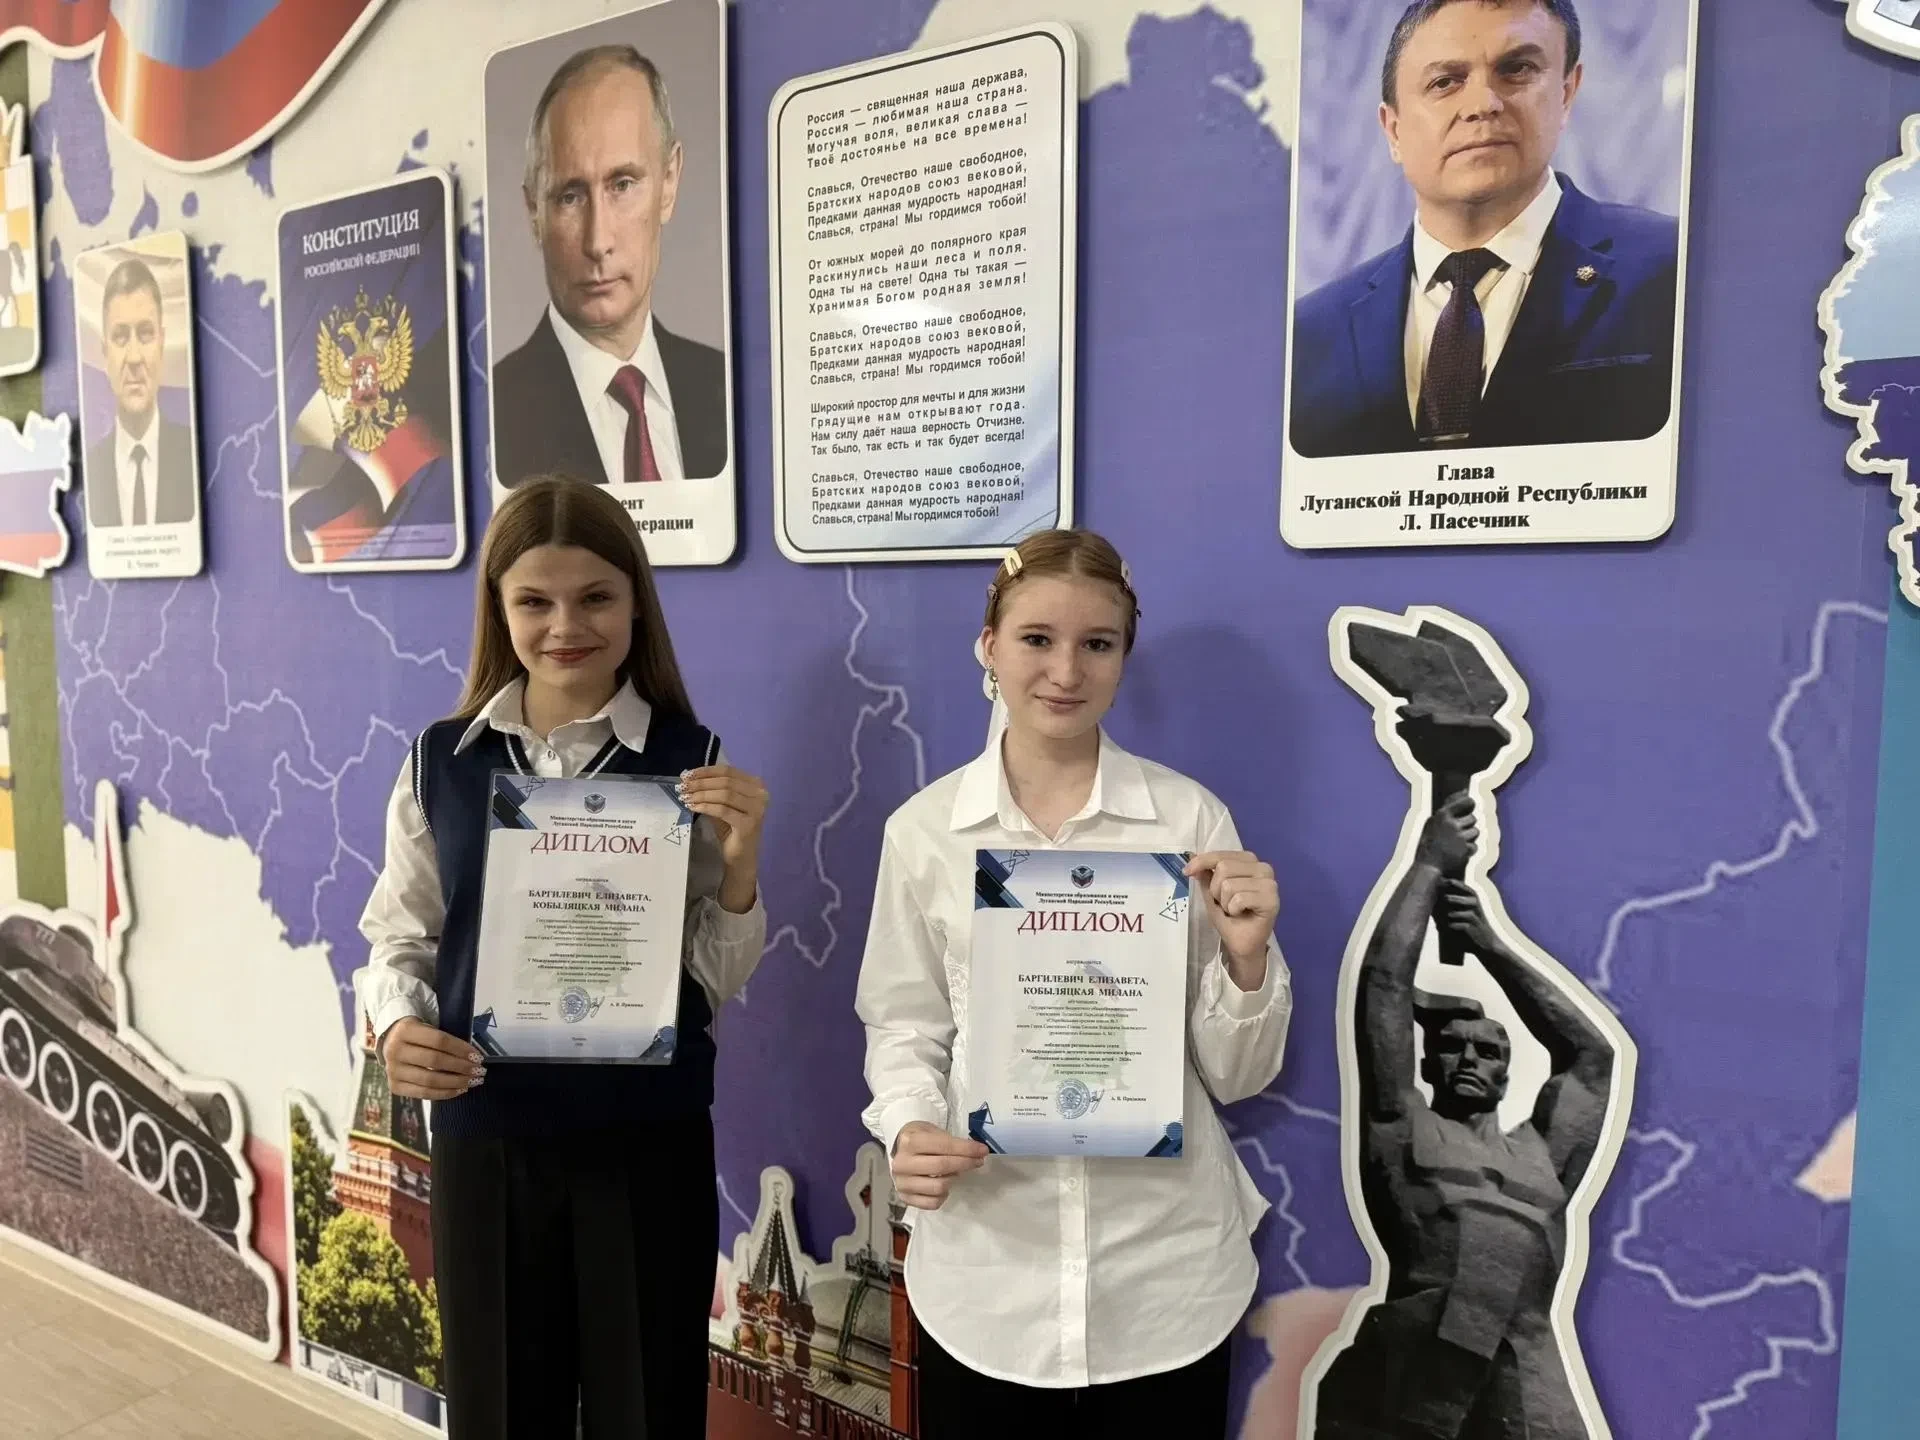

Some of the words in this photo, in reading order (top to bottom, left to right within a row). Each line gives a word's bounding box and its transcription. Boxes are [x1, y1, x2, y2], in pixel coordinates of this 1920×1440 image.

[807, 109, 844, 125] Россия
[866, 89, 928, 112] священная
[935, 81, 965, 96] наша
[971, 68, 1027, 89] держава,
[807, 123, 848, 139] Россия
[872, 105, 928, 126] любимая
[936, 96, 968, 111] наша
[976, 84, 1027, 103] страна.
[807, 136, 857, 154] Могучая
[864, 127, 898, 142] воля,
[906, 113, 959, 133] великая
[967, 103, 1007, 119] слава
[807, 153, 836, 168] Твоё
[840, 140, 906, 163] достоянье
[913, 135, 927, 147] на
[935, 129, 956, 142] все
[964, 113, 1026, 136] времена!
[807, 181, 854, 197] Славься,
[860, 168, 917, 187] Отечество
[923, 161, 952, 175] наше
[959, 148, 1026, 168] свободное,
[808, 192, 861, 212] Братских
[868, 183, 920, 201] народов
[927, 175, 959, 189] союз
[967, 162, 1026, 182] вековой,
[807, 210, 858, 227] Предками
[863, 201, 901, 217] данная
[907, 191, 960, 208] мудрость
[967, 177, 1026, 198] народная!
[808, 226, 853, 241] Славься,
[859, 215, 898, 232] страна!
[904, 213, 922, 224] Мы
[929, 202, 981, 220] гордимся
[987, 193, 1026, 209] тобой!
[303, 209, 419, 255] КОНСТИТУЦИЯ
[808, 259, 822, 269] От
[827, 253, 864, 267] южных
[870, 245, 904, 261] морей
[909, 243, 924, 255] до
[931, 232, 992, 251] полярного
[999, 226, 1026, 240] края
[304, 254, 363, 279] РОССИЙСКОЙ
[808, 265, 888, 285] Раскинулись
[895, 258, 927, 271] наши
[935, 252, 965, 265] леса
[973, 249, 980, 259] и
[988, 243, 1026, 257] поля.
[808, 287, 834, 299] Одна
[840, 284, 854, 294] ты
[860, 281, 872, 291] на
[878, 274, 912, 288] свете!
[918, 269, 947, 283] Одна
[953, 267, 969, 277] ты
[975, 261, 1007, 274] такая
[809, 297, 868, 314] Хранимая
[876, 290, 915, 304] Богом
[923, 282, 970, 299] родная
[979, 273, 1025, 289] земля!
[809, 329, 856, 342] Славься,
[862, 320, 917, 335] Отечество
[924, 316, 952, 327] наше
[959, 306, 1025, 323] свободное,
[810, 342, 863, 356] Братских
[870, 335, 921, 349] народов
[928, 330, 959, 342] союз
[967, 321, 1025, 337] вековой,
[810, 357, 859, 371] Предками
[864, 352, 902, 366] данная
[908, 346, 960, 360] мудрость
[966, 336, 1025, 353] народная!
[810, 373, 855, 385] Славься,
[861, 365, 899, 380] страна!
[905, 363, 923, 374] Мы
[929, 358, 981, 372] гордимся
[987, 351, 1025, 365] тобой!
[810, 399, 854, 413] Широкий
[857, 397, 897, 409] простор
[900, 395, 919, 406] для
[922, 391, 955, 402] мечты
[958, 391, 965, 399] и
[967, 388, 988, 399] для
[990, 384, 1025, 396] жизни
[811, 414, 870, 428] Грядущие
[877, 411, 900, 421] нам
[908, 404, 981, 419] открывают
[989, 400, 1024, 412] года.
[811, 431, 830, 441] Нам
[835, 430, 858, 440] силу
[862, 426, 886, 438] даёт
[890, 425, 916, 435] наша
[922, 420, 971, 433] верность
[976, 416, 1024, 428] Отчизне.
[812, 445, 827, 455] Так
[831, 444, 860, 454] было,
[865, 442, 882, 451] так
[886, 440, 909, 450] есть
[913, 439, 921, 448] и
[926, 437, 943, 447] так
[948, 434, 979, 446] будет
[985, 430, 1024, 442] всегда!
[811, 473, 857, 483] Славься,
[863, 468, 918, 479] Отечество
[924, 466, 952, 476] наше
[958, 462, 1024, 474] свободное,
[812, 485, 864, 497] Братских
[871, 483, 921, 494] народов
[928, 480, 959, 491] союз
[967, 476, 1024, 488] вековой,
[1437, 464, 1495, 481] Глава
[812, 500, 860, 511] Предками
[866, 498, 903, 509] данная
[909, 495, 960, 507] мудрость
[964, 491, 1024, 504] народная!
[1300, 492, 1402, 513] Луганской
[1408, 486, 1510, 509] Народной
[1517, 483, 1648, 506] Республики
[812, 515, 855, 525] Славься,
[856, 511, 893, 523] страна!
[894, 511, 912, 521] Мы
[913, 510, 962, 521] гордимся
[963, 507, 998, 518] тобой!
[1399, 514, 1421, 531] Л.
[1429, 512, 1530, 530] Пасечник
[530, 832, 650, 855] ДИПЛОМ
[528, 890, 591, 899] БАРГИЛЕВИЧ
[533, 901, 600, 911] КОБЫЛЯЦКАЯ
[604, 904, 646, 912] МИЛАНА
[1017, 910, 1145, 935] ДИПЛОМ
[1018, 974, 1083, 984] БАРГИЛЕВИЧ
[1088, 975, 1149, 986] ЕЛИЗАВЕТА,
[1023, 987, 1094, 998] КОБЫЛЯЦКАЯ
[1098, 988, 1143, 997] МИЛАНА
